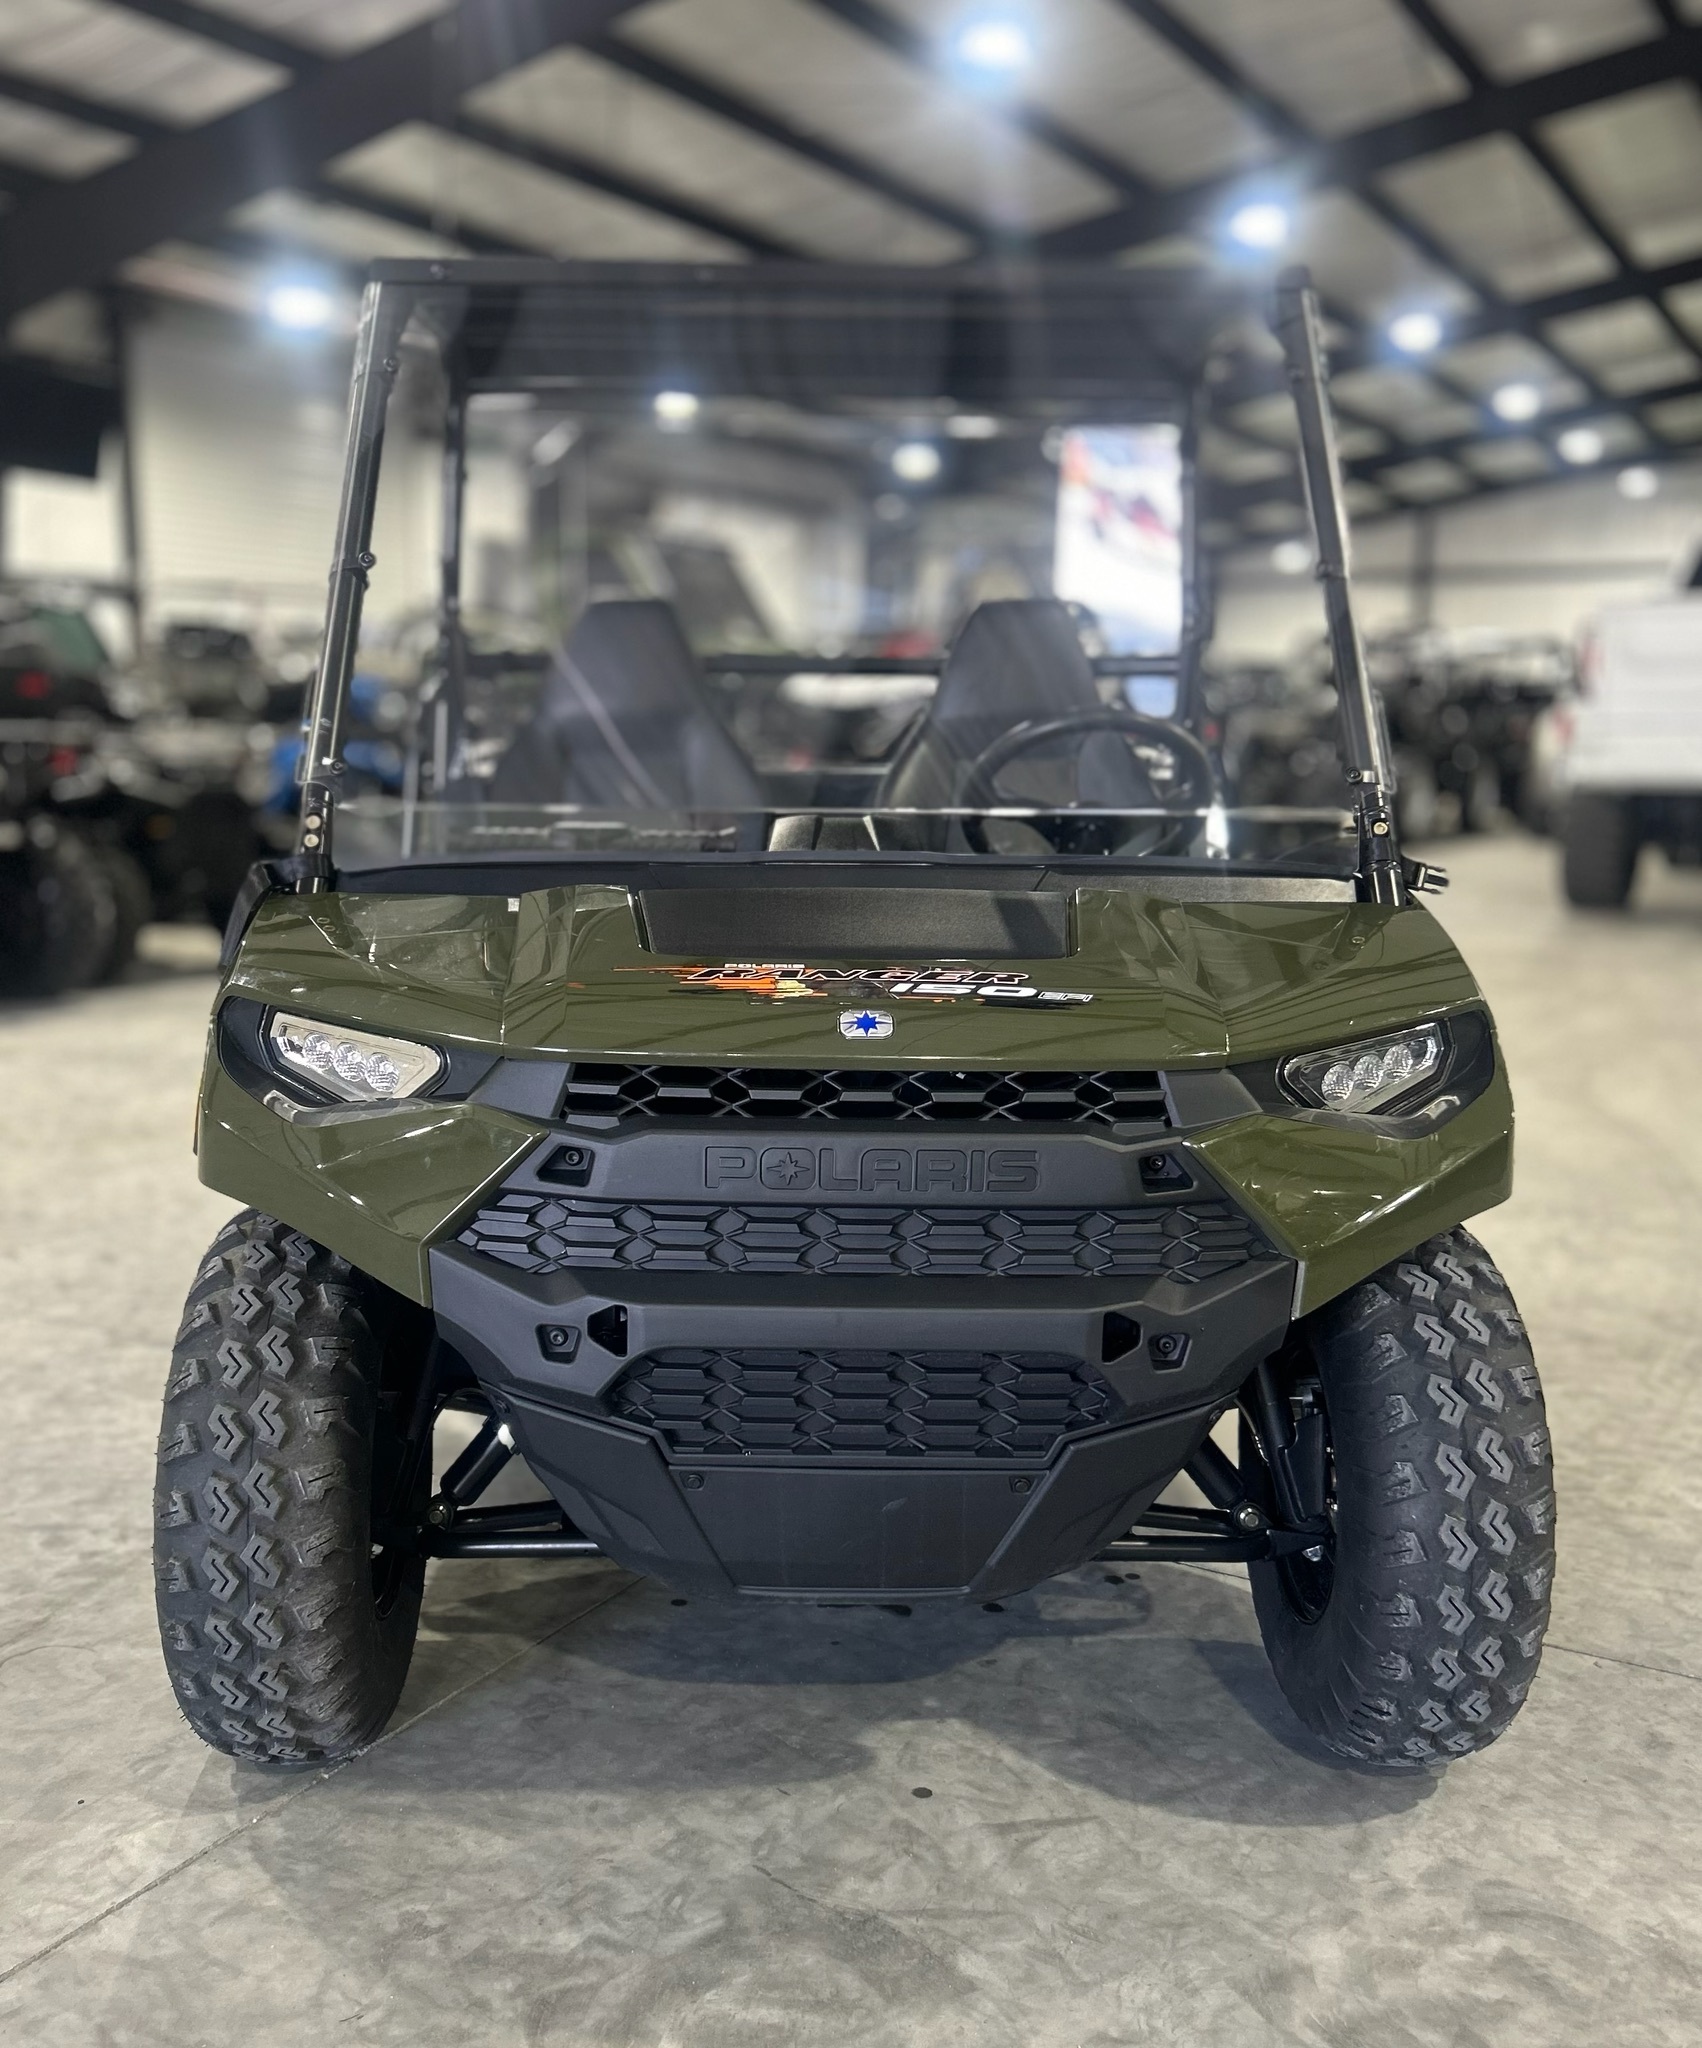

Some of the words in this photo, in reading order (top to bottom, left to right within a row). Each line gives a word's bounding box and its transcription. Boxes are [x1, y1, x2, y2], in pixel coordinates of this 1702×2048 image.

[687, 967, 1029, 984] RANGER
[889, 983, 1038, 998] 150
[704, 1146, 1040, 1193] POLARIS
